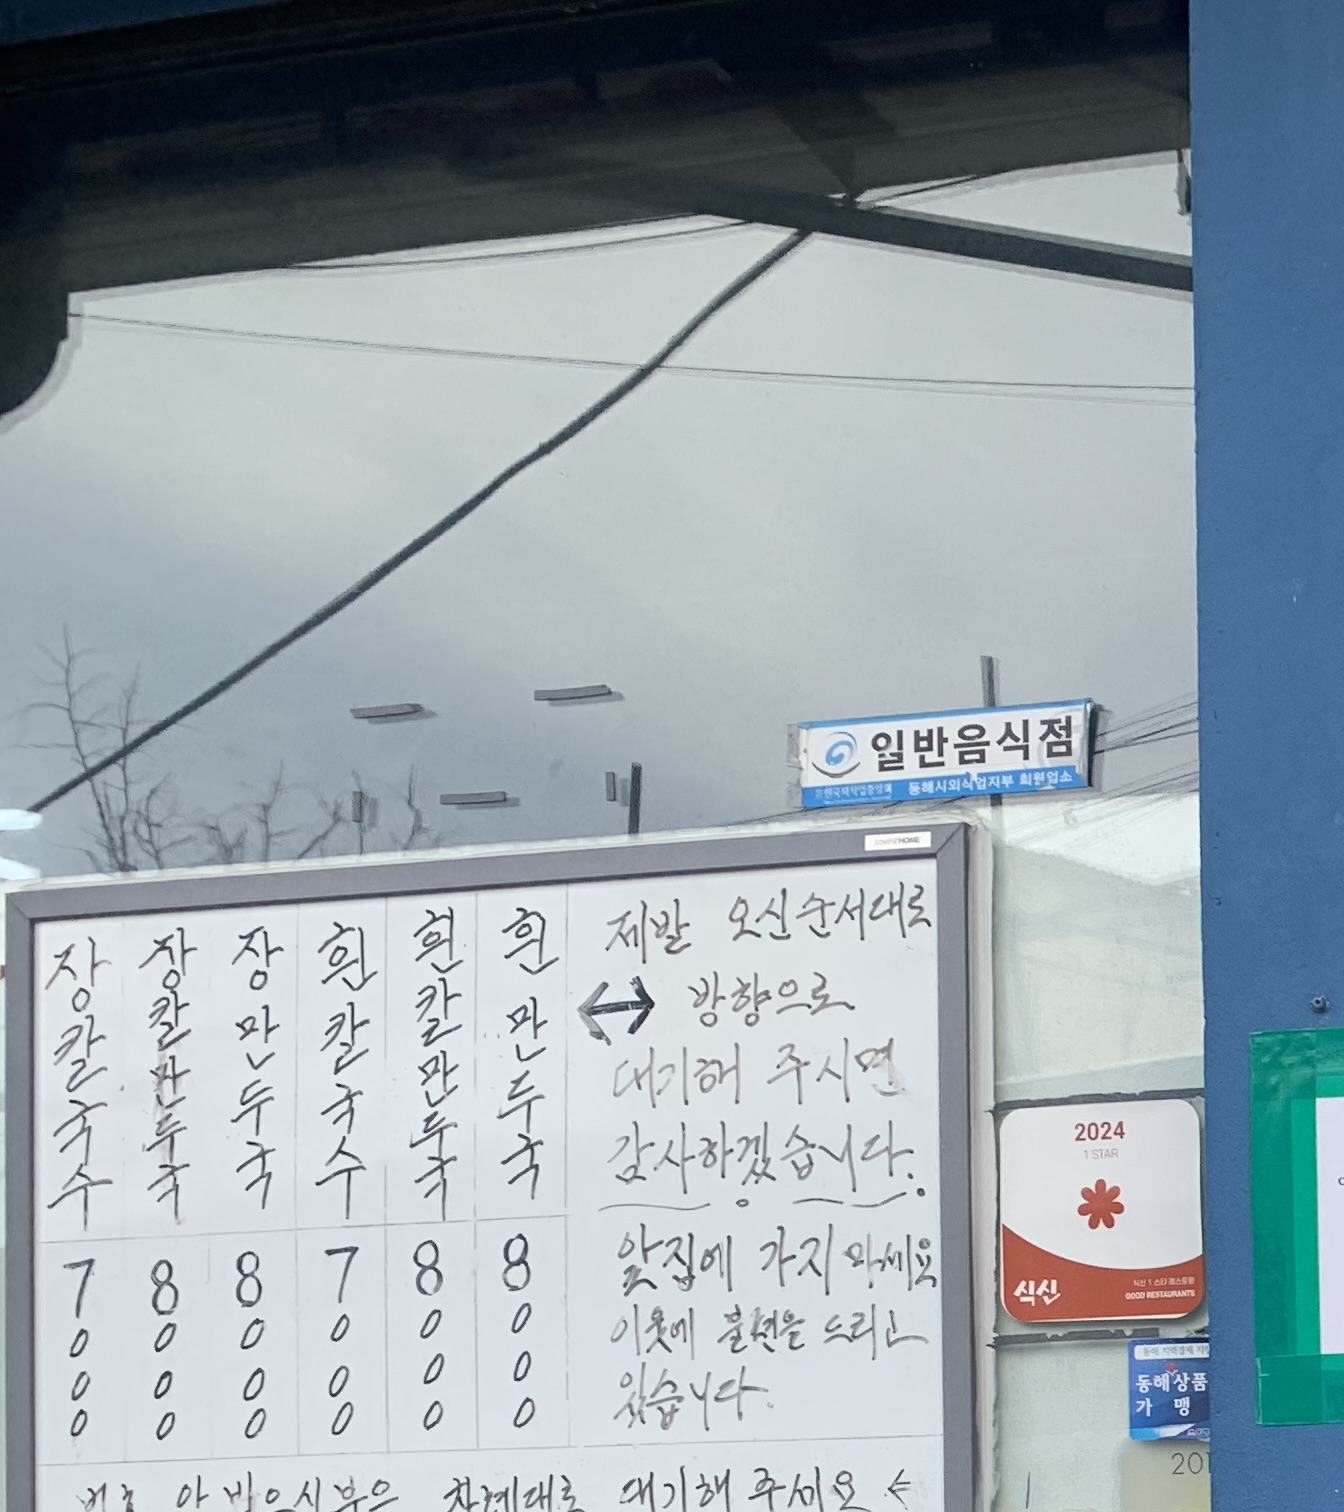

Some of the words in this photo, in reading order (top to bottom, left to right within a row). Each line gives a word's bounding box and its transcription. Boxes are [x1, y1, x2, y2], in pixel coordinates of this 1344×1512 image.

[872, 716, 1073, 772] 일반음식점
[908, 773, 1014, 796] 동해시외식업지부
[1019, 770, 1072, 786] 회원업소
[606, 898, 691, 964] 제발
[688, 971, 855, 1026] 방향으로
[45, 936, 113, 1232] 장칼국수
[613, 1042, 741, 1108] 대기해
[767, 1037, 906, 1101] 주시면
[1074, 1121, 1126, 1142] 2024
[1091, 1148, 1119, 1160] STAR
[760, 1223, 833, 1296] 가지
[1014, 1278, 1061, 1306] 식신
[1146, 1289, 1196, 1299] RESTAURANTS
[823, 1304, 930, 1361] 드리고
